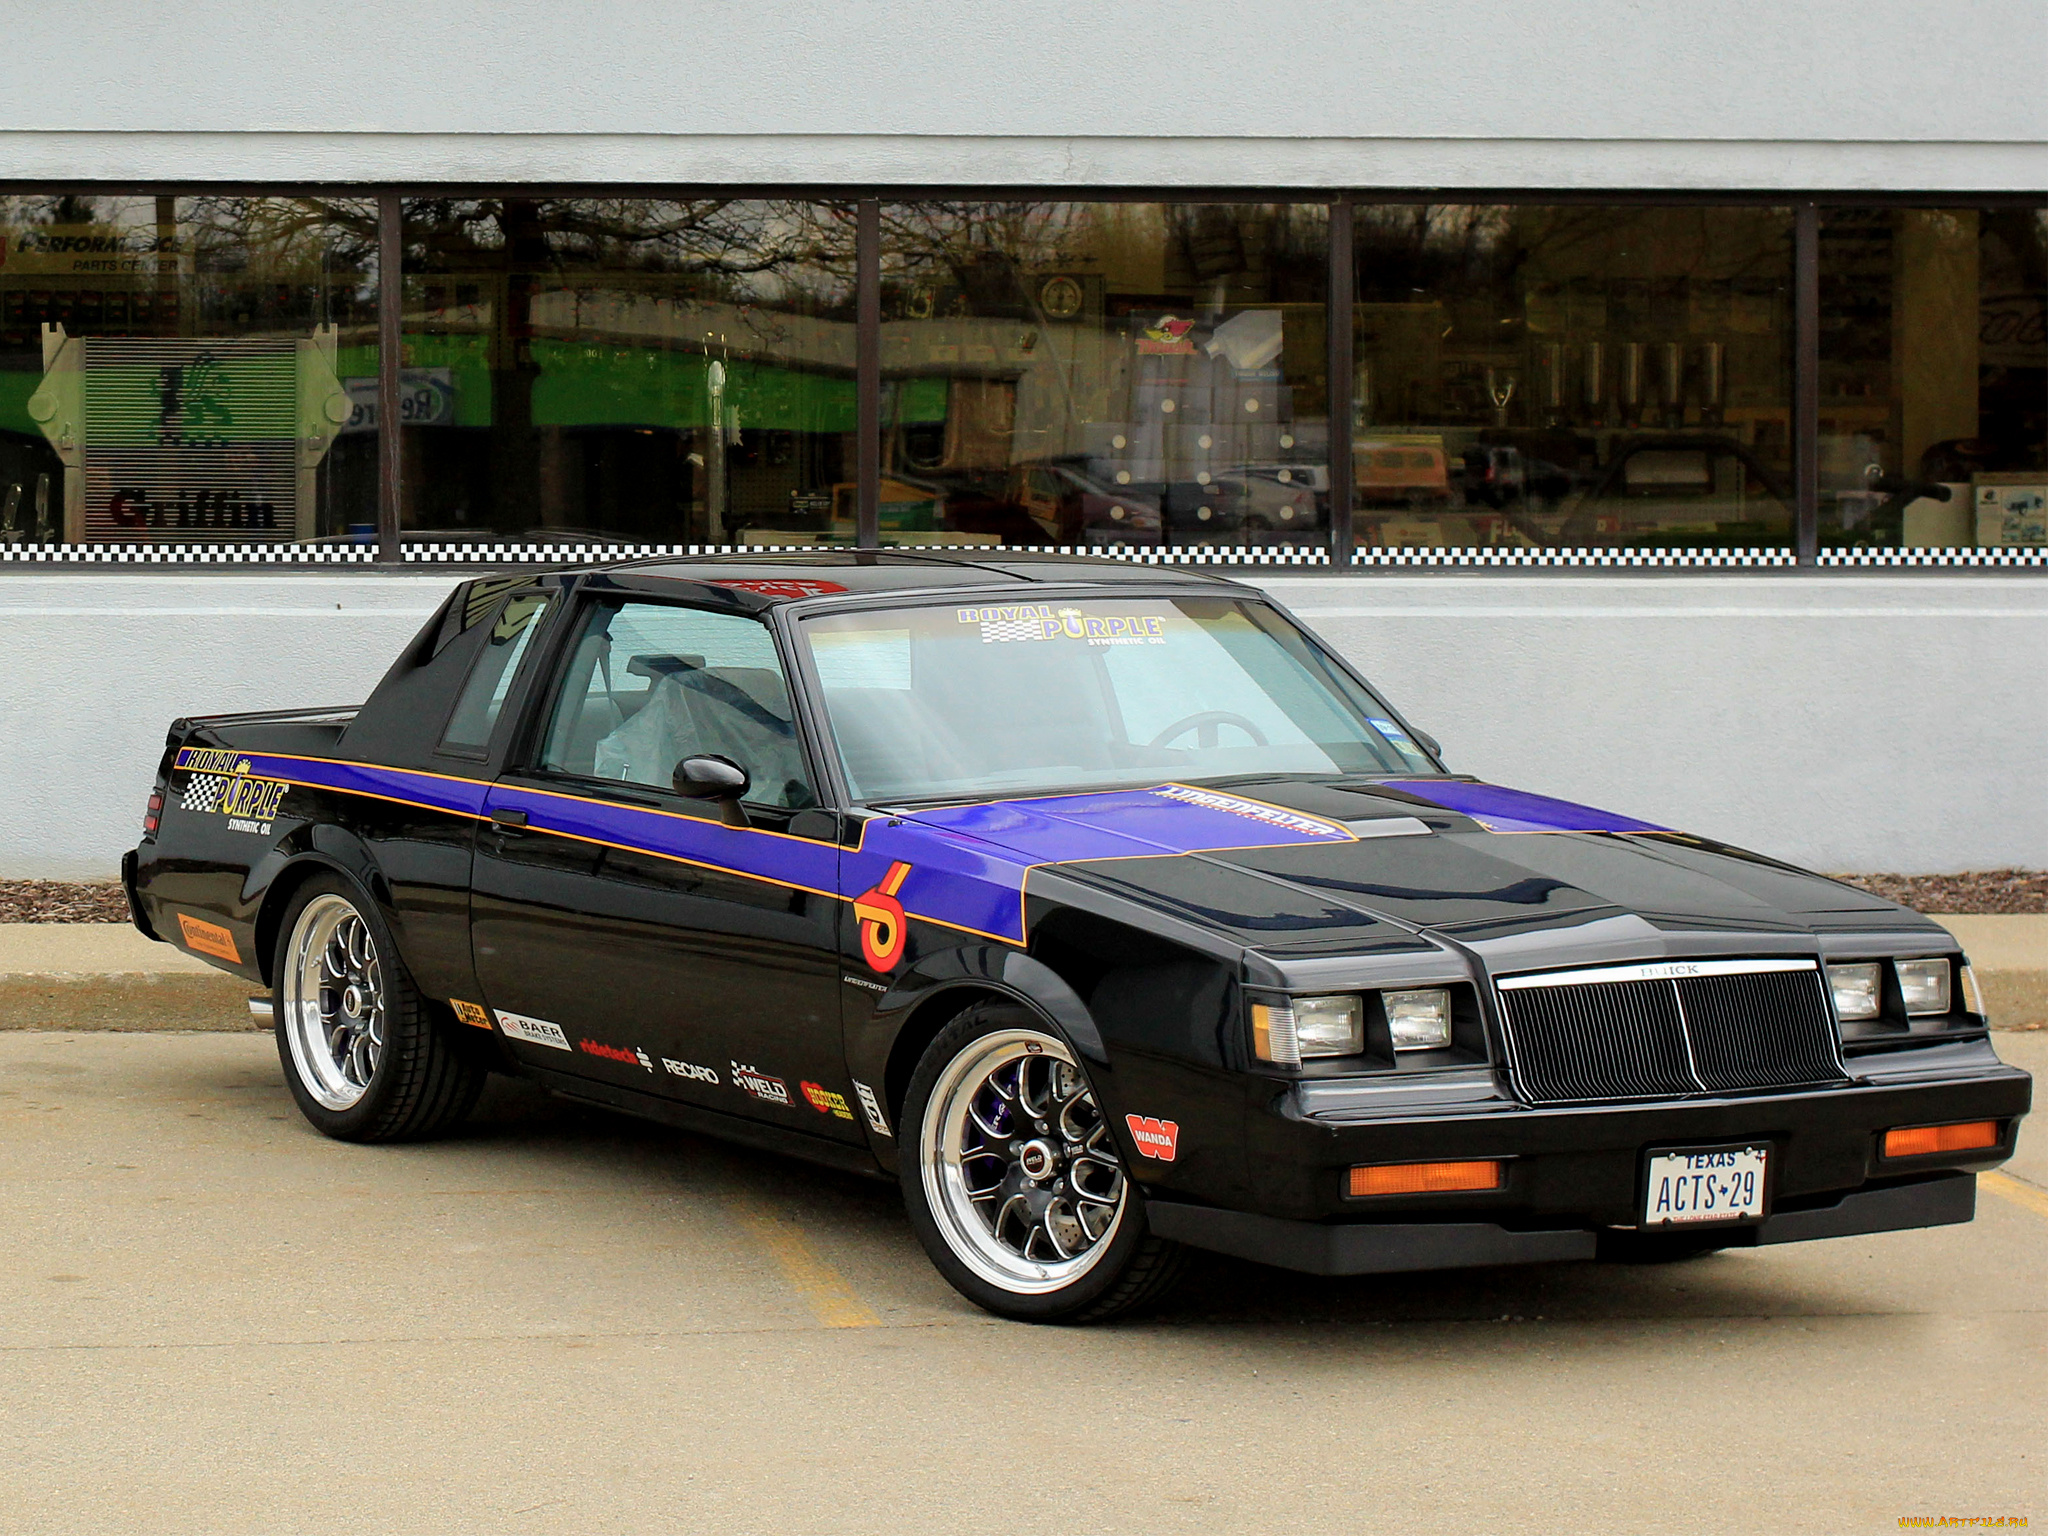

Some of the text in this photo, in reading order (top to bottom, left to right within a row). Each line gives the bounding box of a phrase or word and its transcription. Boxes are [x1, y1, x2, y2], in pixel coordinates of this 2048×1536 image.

[17, 233, 182, 253] PERFORMCE
[73, 260, 178, 271] PARTS CENER
[957, 605, 1055, 623] ROYAL
[1041, 614, 1164, 640] PURPLE
[1088, 636, 1166, 646] SYNTHETIC OIL
[184, 750, 239, 774] ROYAL
[209, 776, 286, 820] PURPLE
[1162, 786, 1337, 835] LINGENFELTER
[227, 818, 272, 836] SYNTHETIC OIL
[1641, 965, 1699, 977] BUICK
[519, 1020, 562, 1038] BAER
[661, 1057, 719, 1085] RECARO
[743, 1075, 787, 1098] WELD
[757, 1091, 788, 1104] RACING
[806, 1086, 850, 1112] HOOKER
[1135, 1130, 1173, 1147] WANDA
[1685, 1152, 1736, 1170] TEXAS
